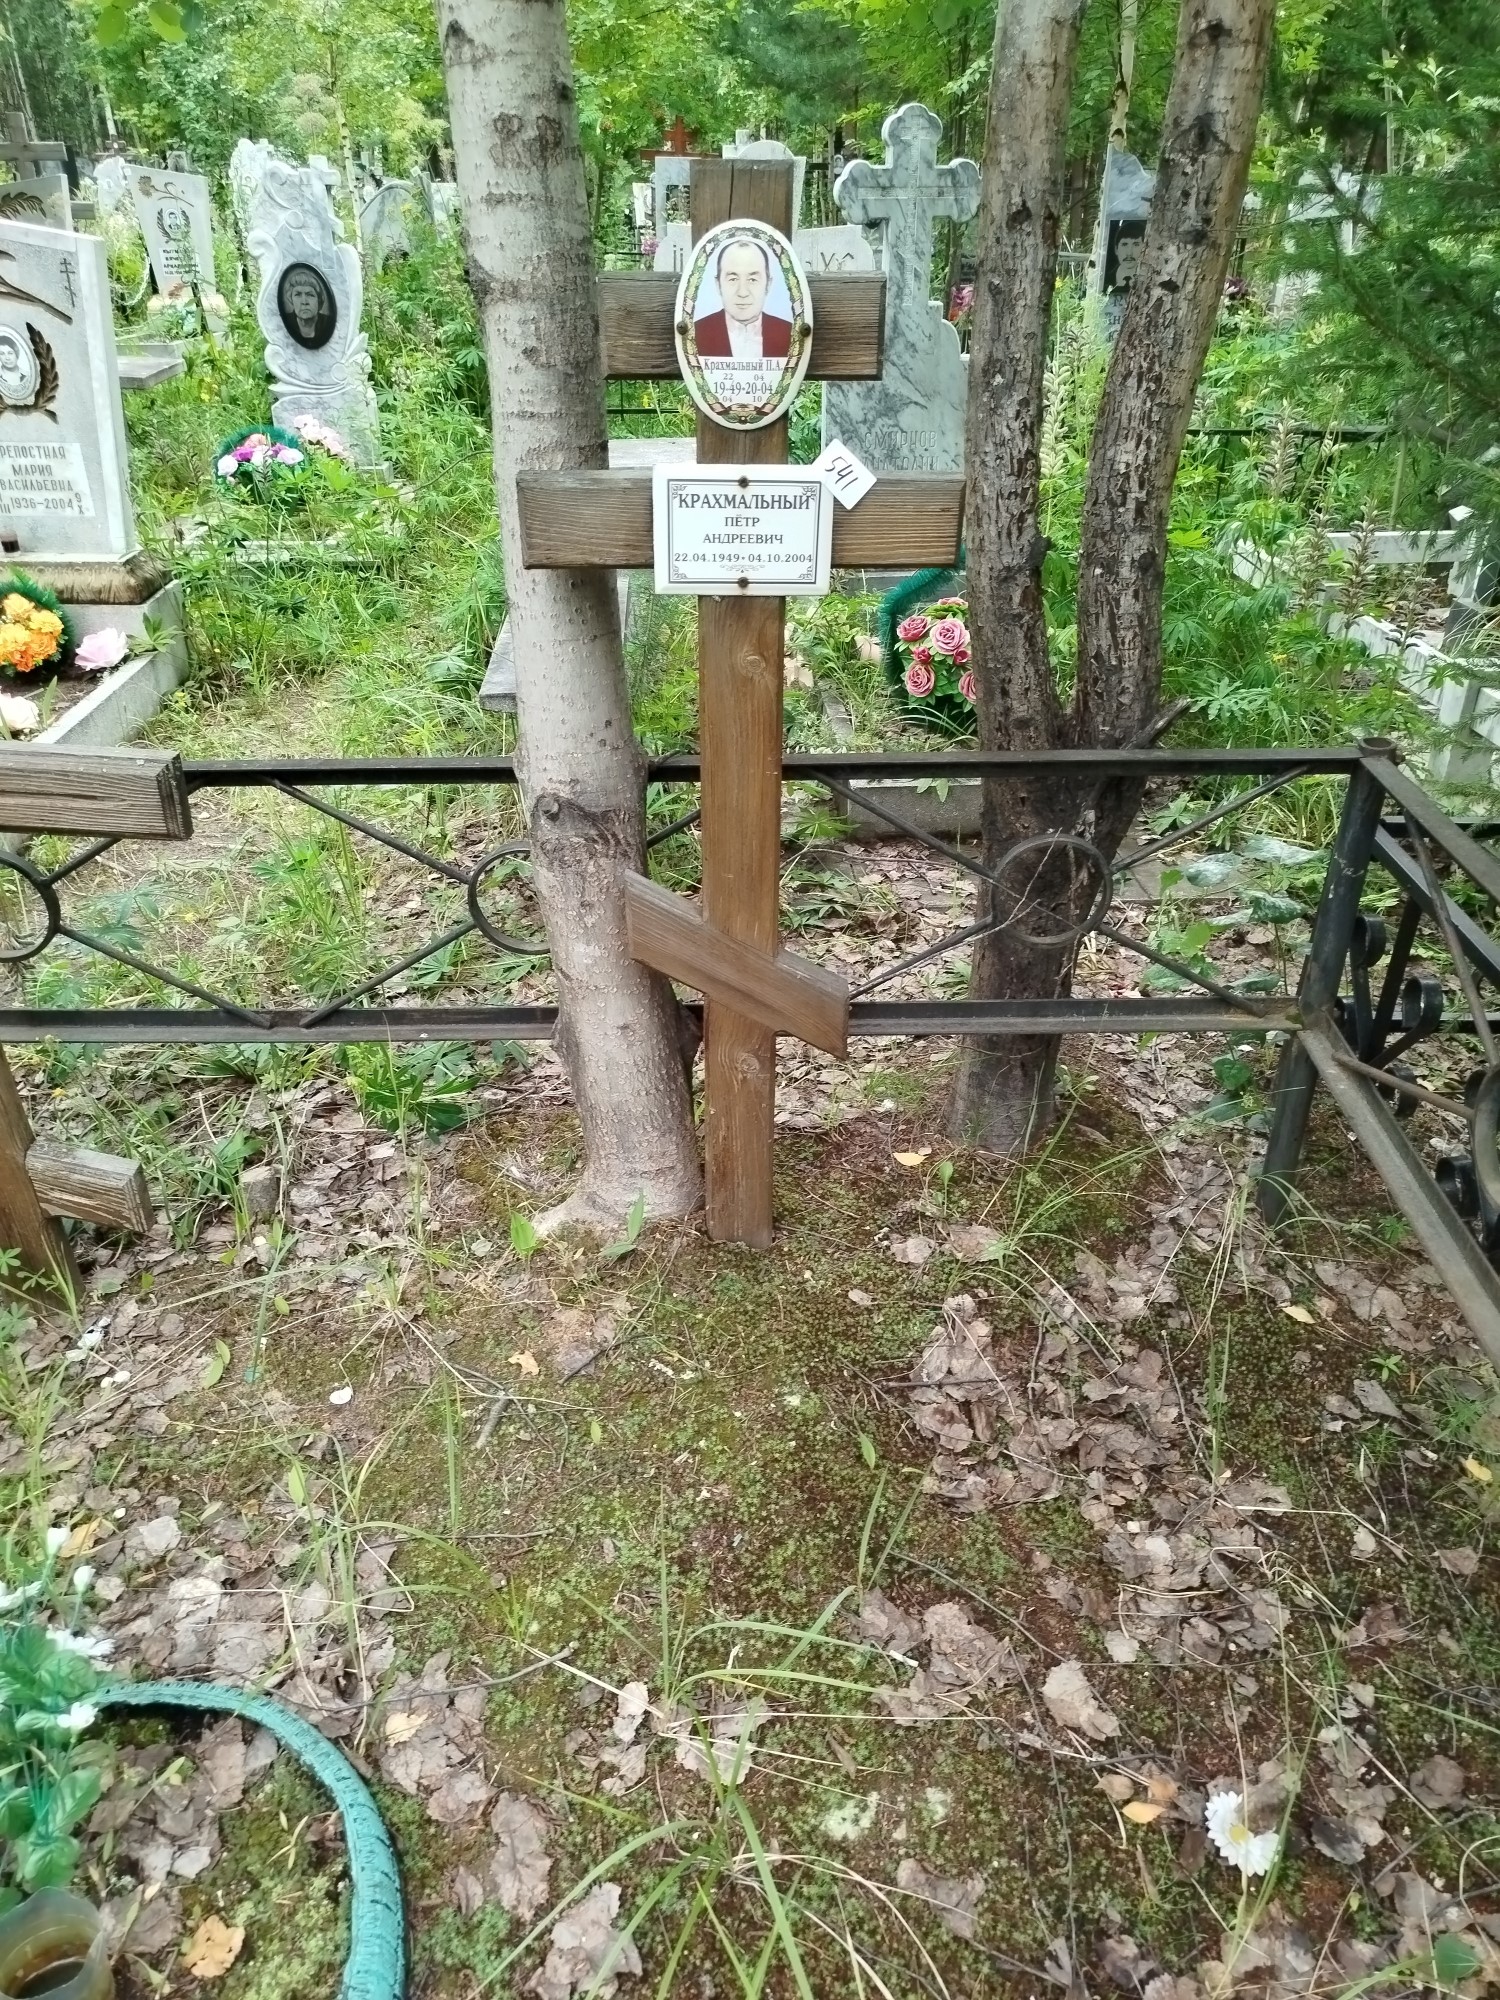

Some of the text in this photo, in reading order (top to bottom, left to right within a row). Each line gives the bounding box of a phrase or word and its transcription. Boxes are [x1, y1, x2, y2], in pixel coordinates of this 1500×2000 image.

[704, 359, 784, 374] Крахмальный П.А.
[864, 430, 937, 450] СМИРНОВ
[12, 464, 53, 476] МАРИЯ
[825, 456, 859, 491] 541
[0, 479, 73, 491] ВАСИЛЬЕВНА
[678, 493, 810, 509] КРАХМАЛЬНЫЙ
[724, 514, 760, 527] ПЁТР
[702, 533, 784, 544] АНДРЕЕВИЧ
